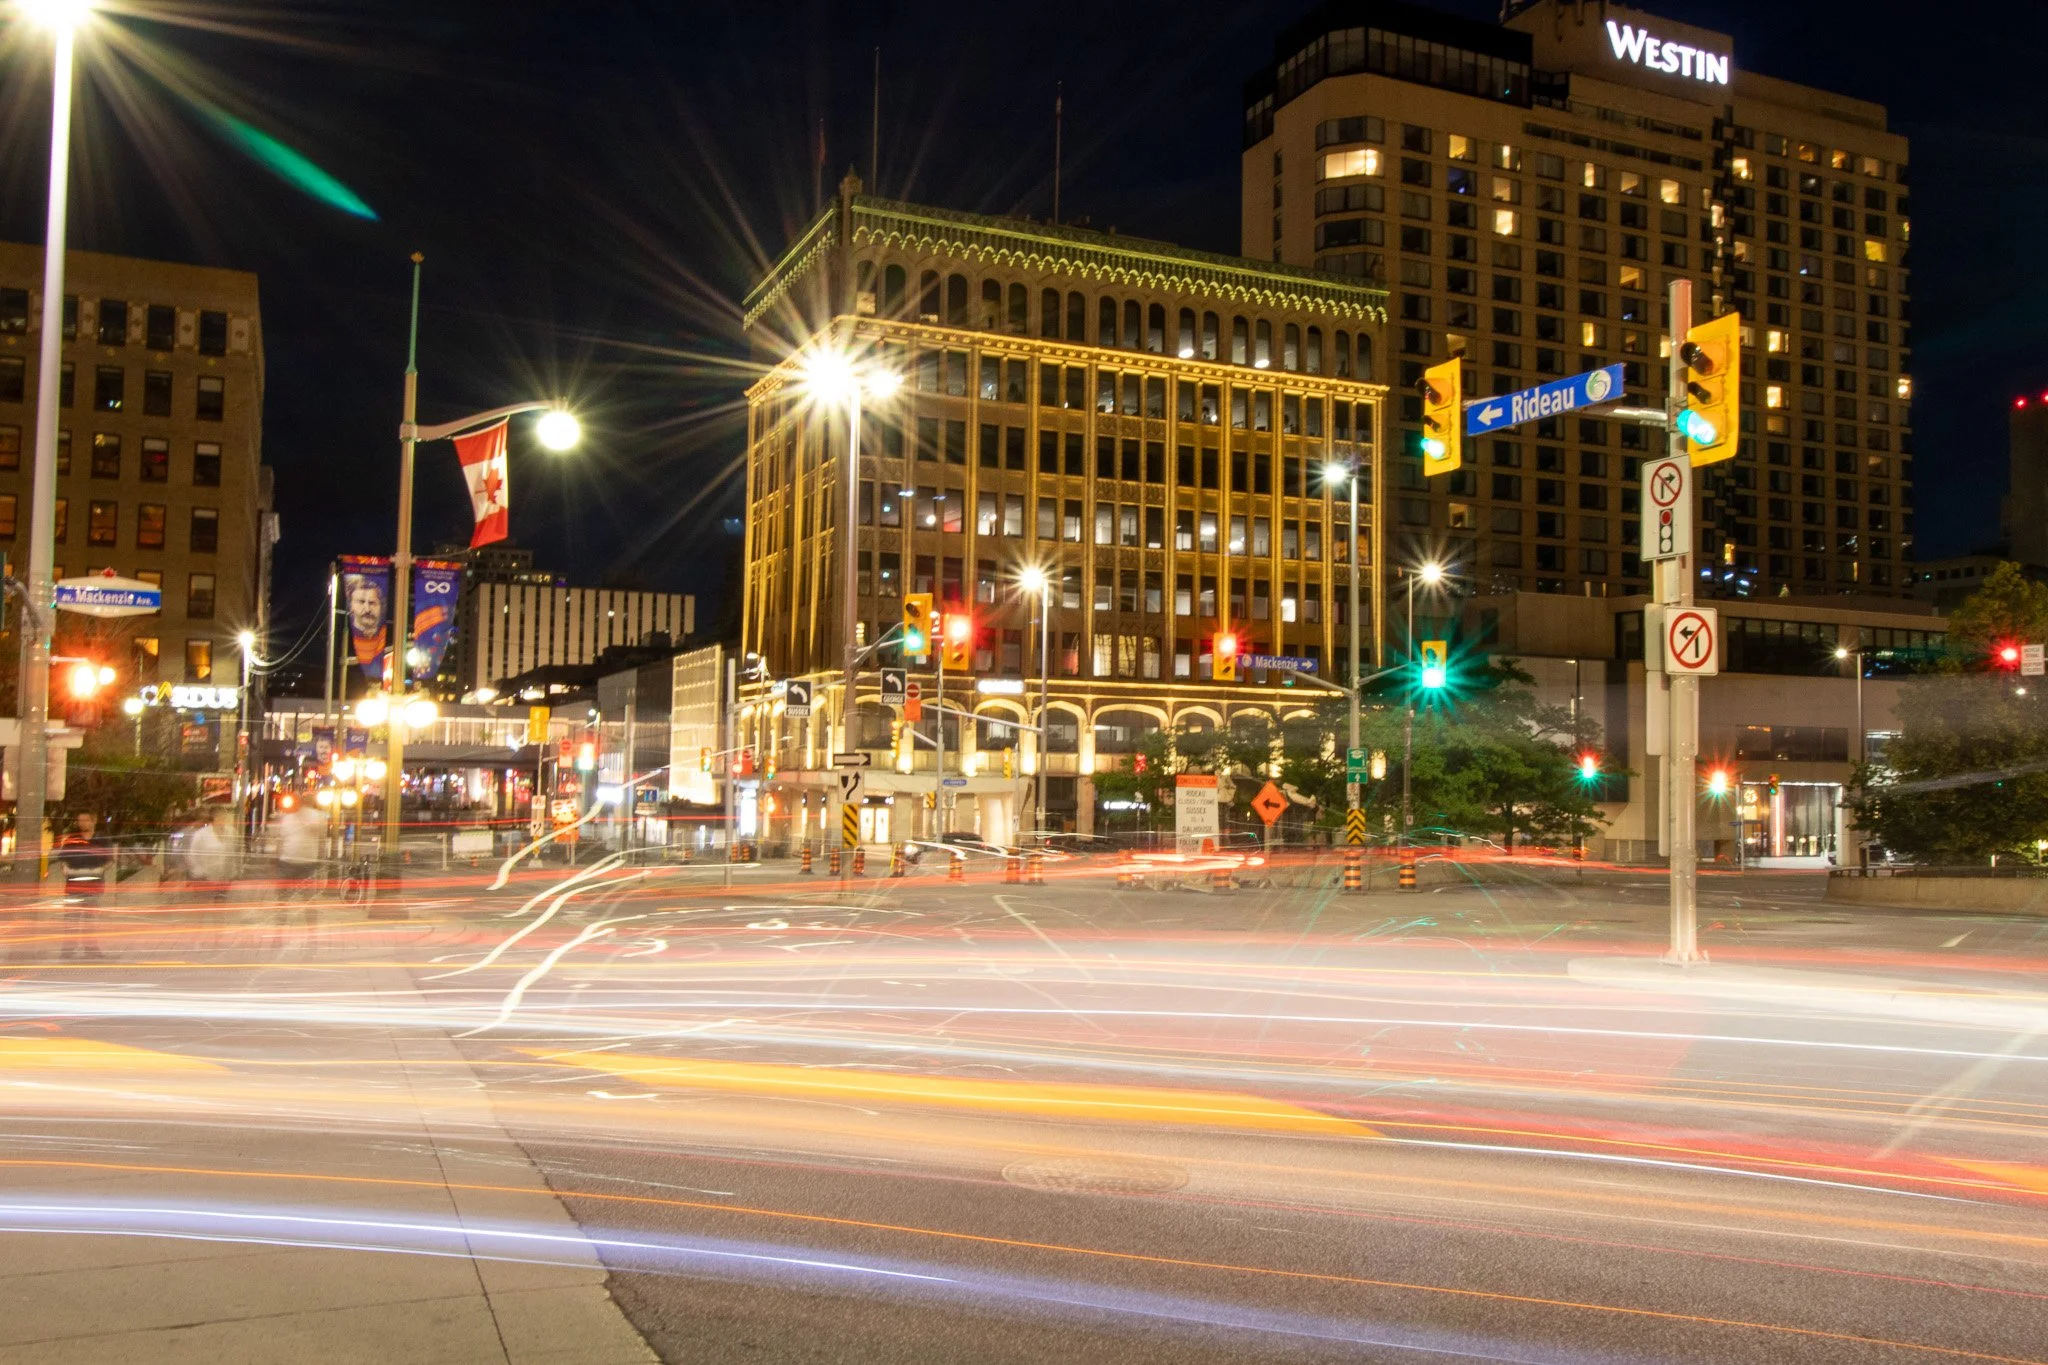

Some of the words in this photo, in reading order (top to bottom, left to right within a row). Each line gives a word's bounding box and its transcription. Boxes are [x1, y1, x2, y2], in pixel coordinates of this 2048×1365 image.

[1606, 20, 1728, 85] WESTIN
[1512, 386, 1574, 424] Rideau
[75, 588, 134, 605] Mackenzie
[1255, 656, 1299, 670] Mackenzie
